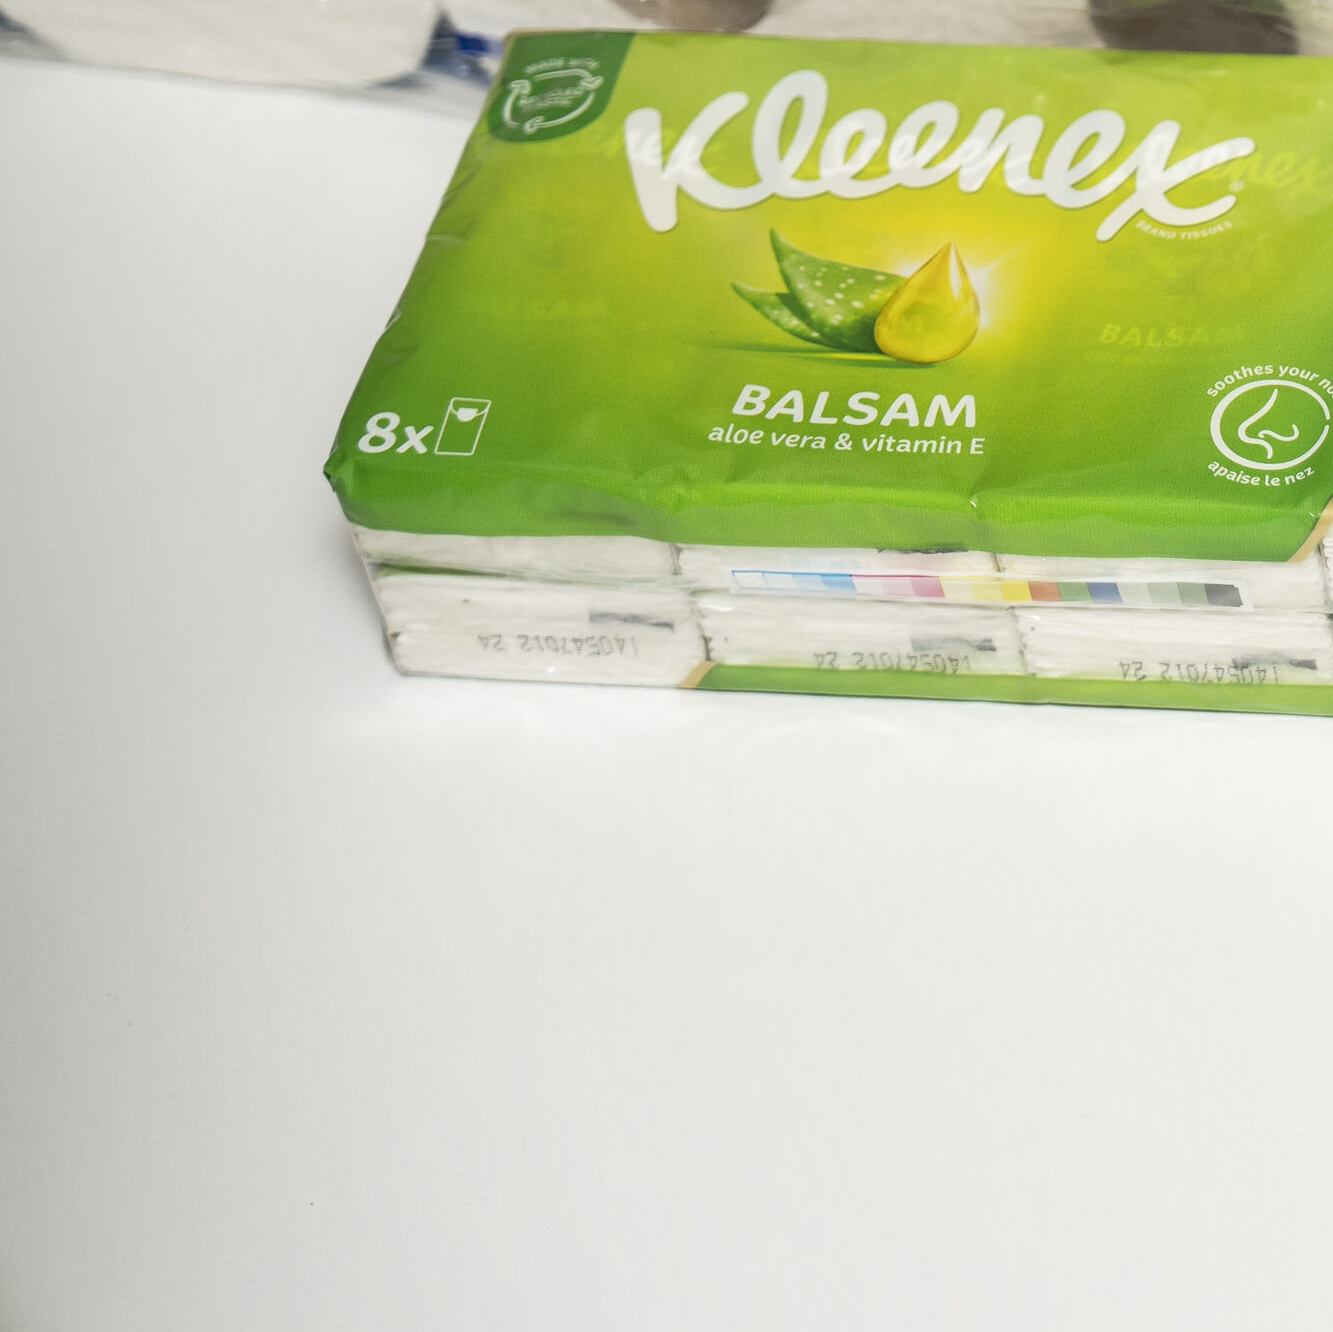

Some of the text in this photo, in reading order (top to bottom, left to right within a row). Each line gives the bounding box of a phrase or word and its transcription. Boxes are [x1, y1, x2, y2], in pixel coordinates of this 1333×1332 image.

[623, 70, 1255, 243] Kleenex
[1135, 219, 1233, 240] BRAND TISSUES
[1206, 365, 1273, 398] soothes
[1279, 365, 1318, 383] your
[730, 384, 976, 429] BALSAM
[357, 411, 435, 455] 8x
[707, 422, 985, 455] aloe vera & vitamin E
[1207, 460, 1315, 487] apaise le nez
[477, 633, 505, 653] 24
[813, 652, 839, 669] 24
[1119, 661, 1146, 680] 24
